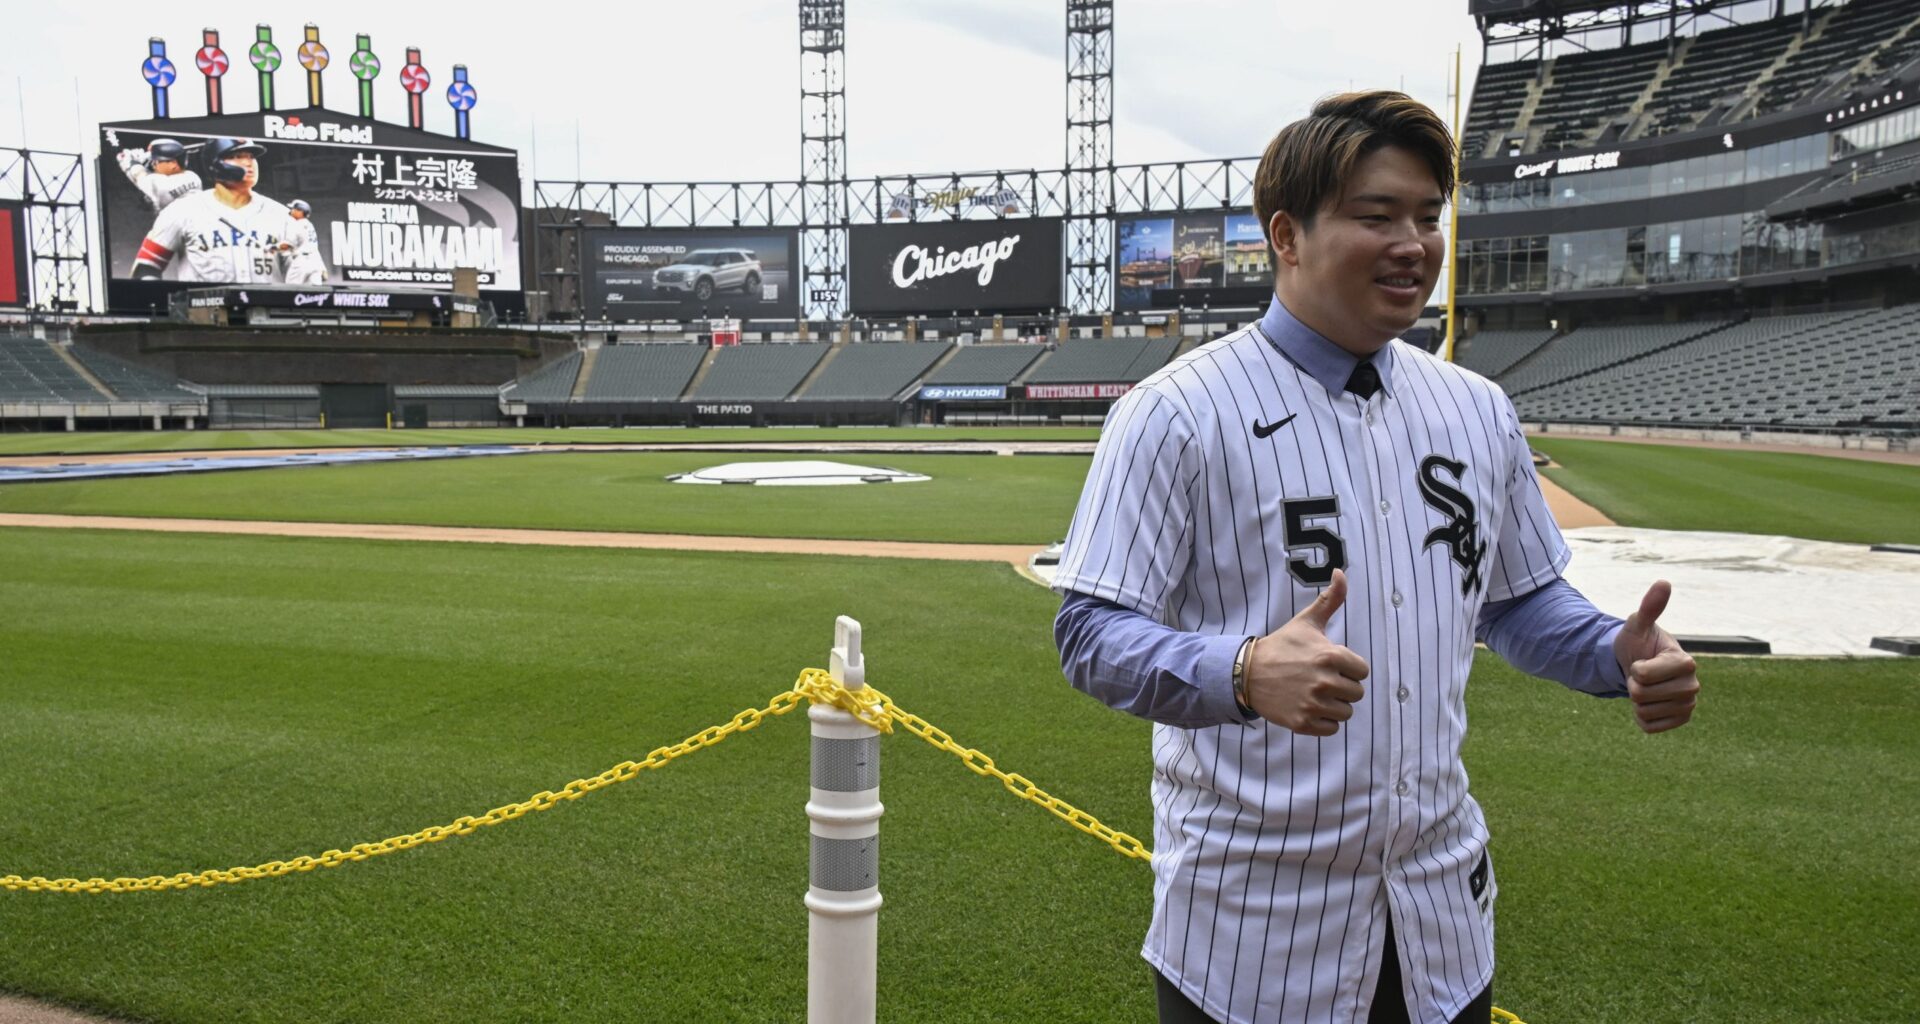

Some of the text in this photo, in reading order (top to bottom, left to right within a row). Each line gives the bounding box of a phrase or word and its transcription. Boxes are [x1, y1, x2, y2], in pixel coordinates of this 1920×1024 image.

[264, 115, 372, 143] Rate Field
[352, 153, 478, 190] 村上宗隆
[331, 221, 503, 272] MURAKAMI
[604, 246, 686, 254] PROUDLY ASSEMBLED
[604, 255, 613, 263] IN
[892, 235, 1020, 288] Chicago
[254, 258, 273, 275] 55
[348, 270, 413, 281] WELCOME
[415, 272, 432, 282] TO
[206, 298, 224, 306] DECK
[333, 294, 367, 306] WHITE
[367, 295, 389, 307] SOX
[946, 389, 1000, 397] HYUNDAI
[1030, 386, 1094, 398] WHITTINGHAM
[697, 405, 752, 414] THE PATIO
[1280, 494, 1348, 588] 5
